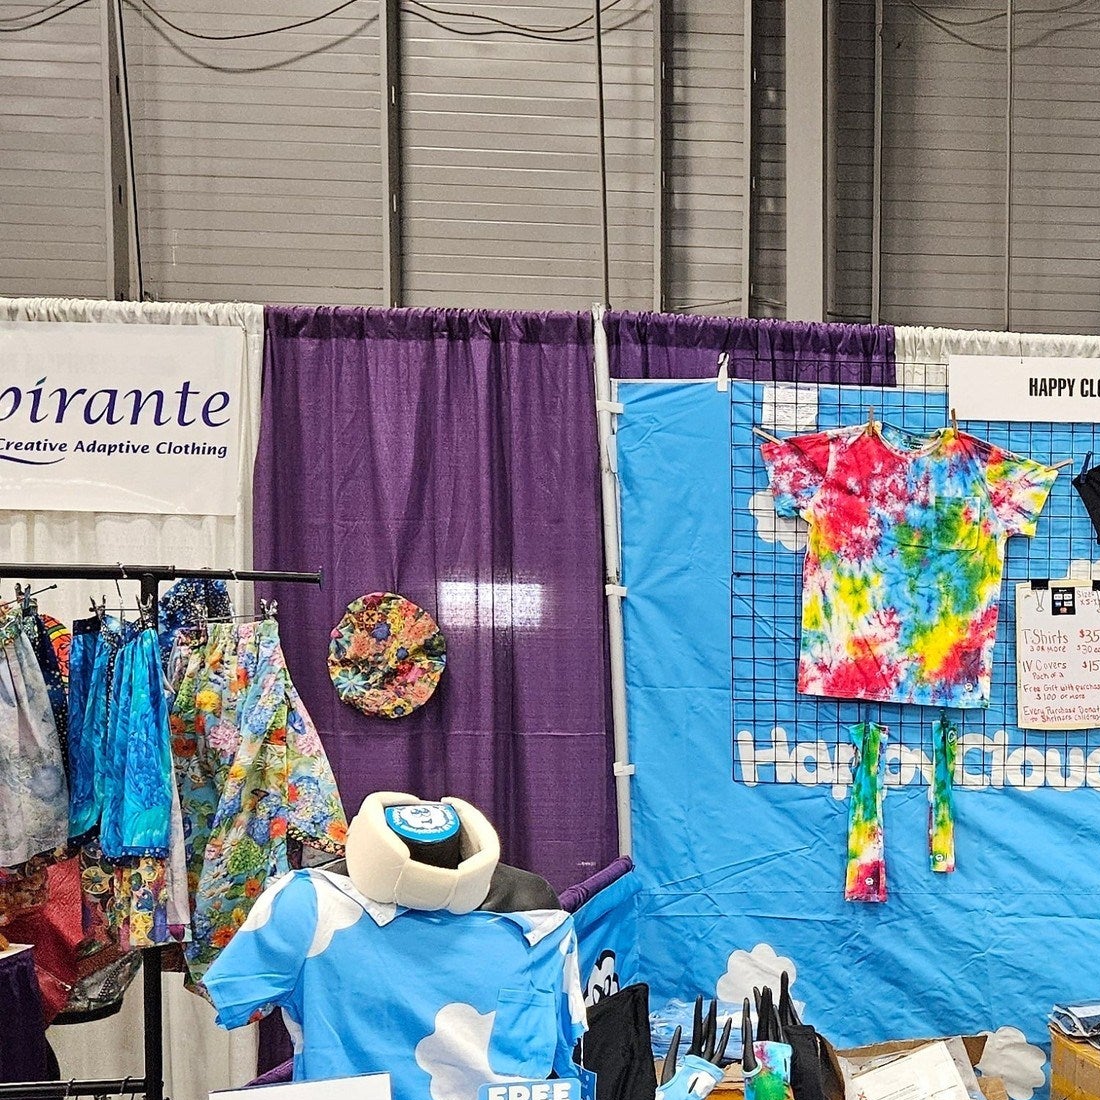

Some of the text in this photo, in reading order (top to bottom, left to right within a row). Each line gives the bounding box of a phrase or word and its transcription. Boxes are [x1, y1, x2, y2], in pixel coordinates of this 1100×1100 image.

[1029, 377, 1074, 398] HAPPY
[74, 440, 150, 456] Adaptive
[155, 441, 228, 459] Clothing
[1076, 645, 1092, 654] $30
[1022, 659, 1100, 673] IV Covers $15
[1023, 684, 1041, 693] Free
[1043, 684, 1058, 692] Gift
